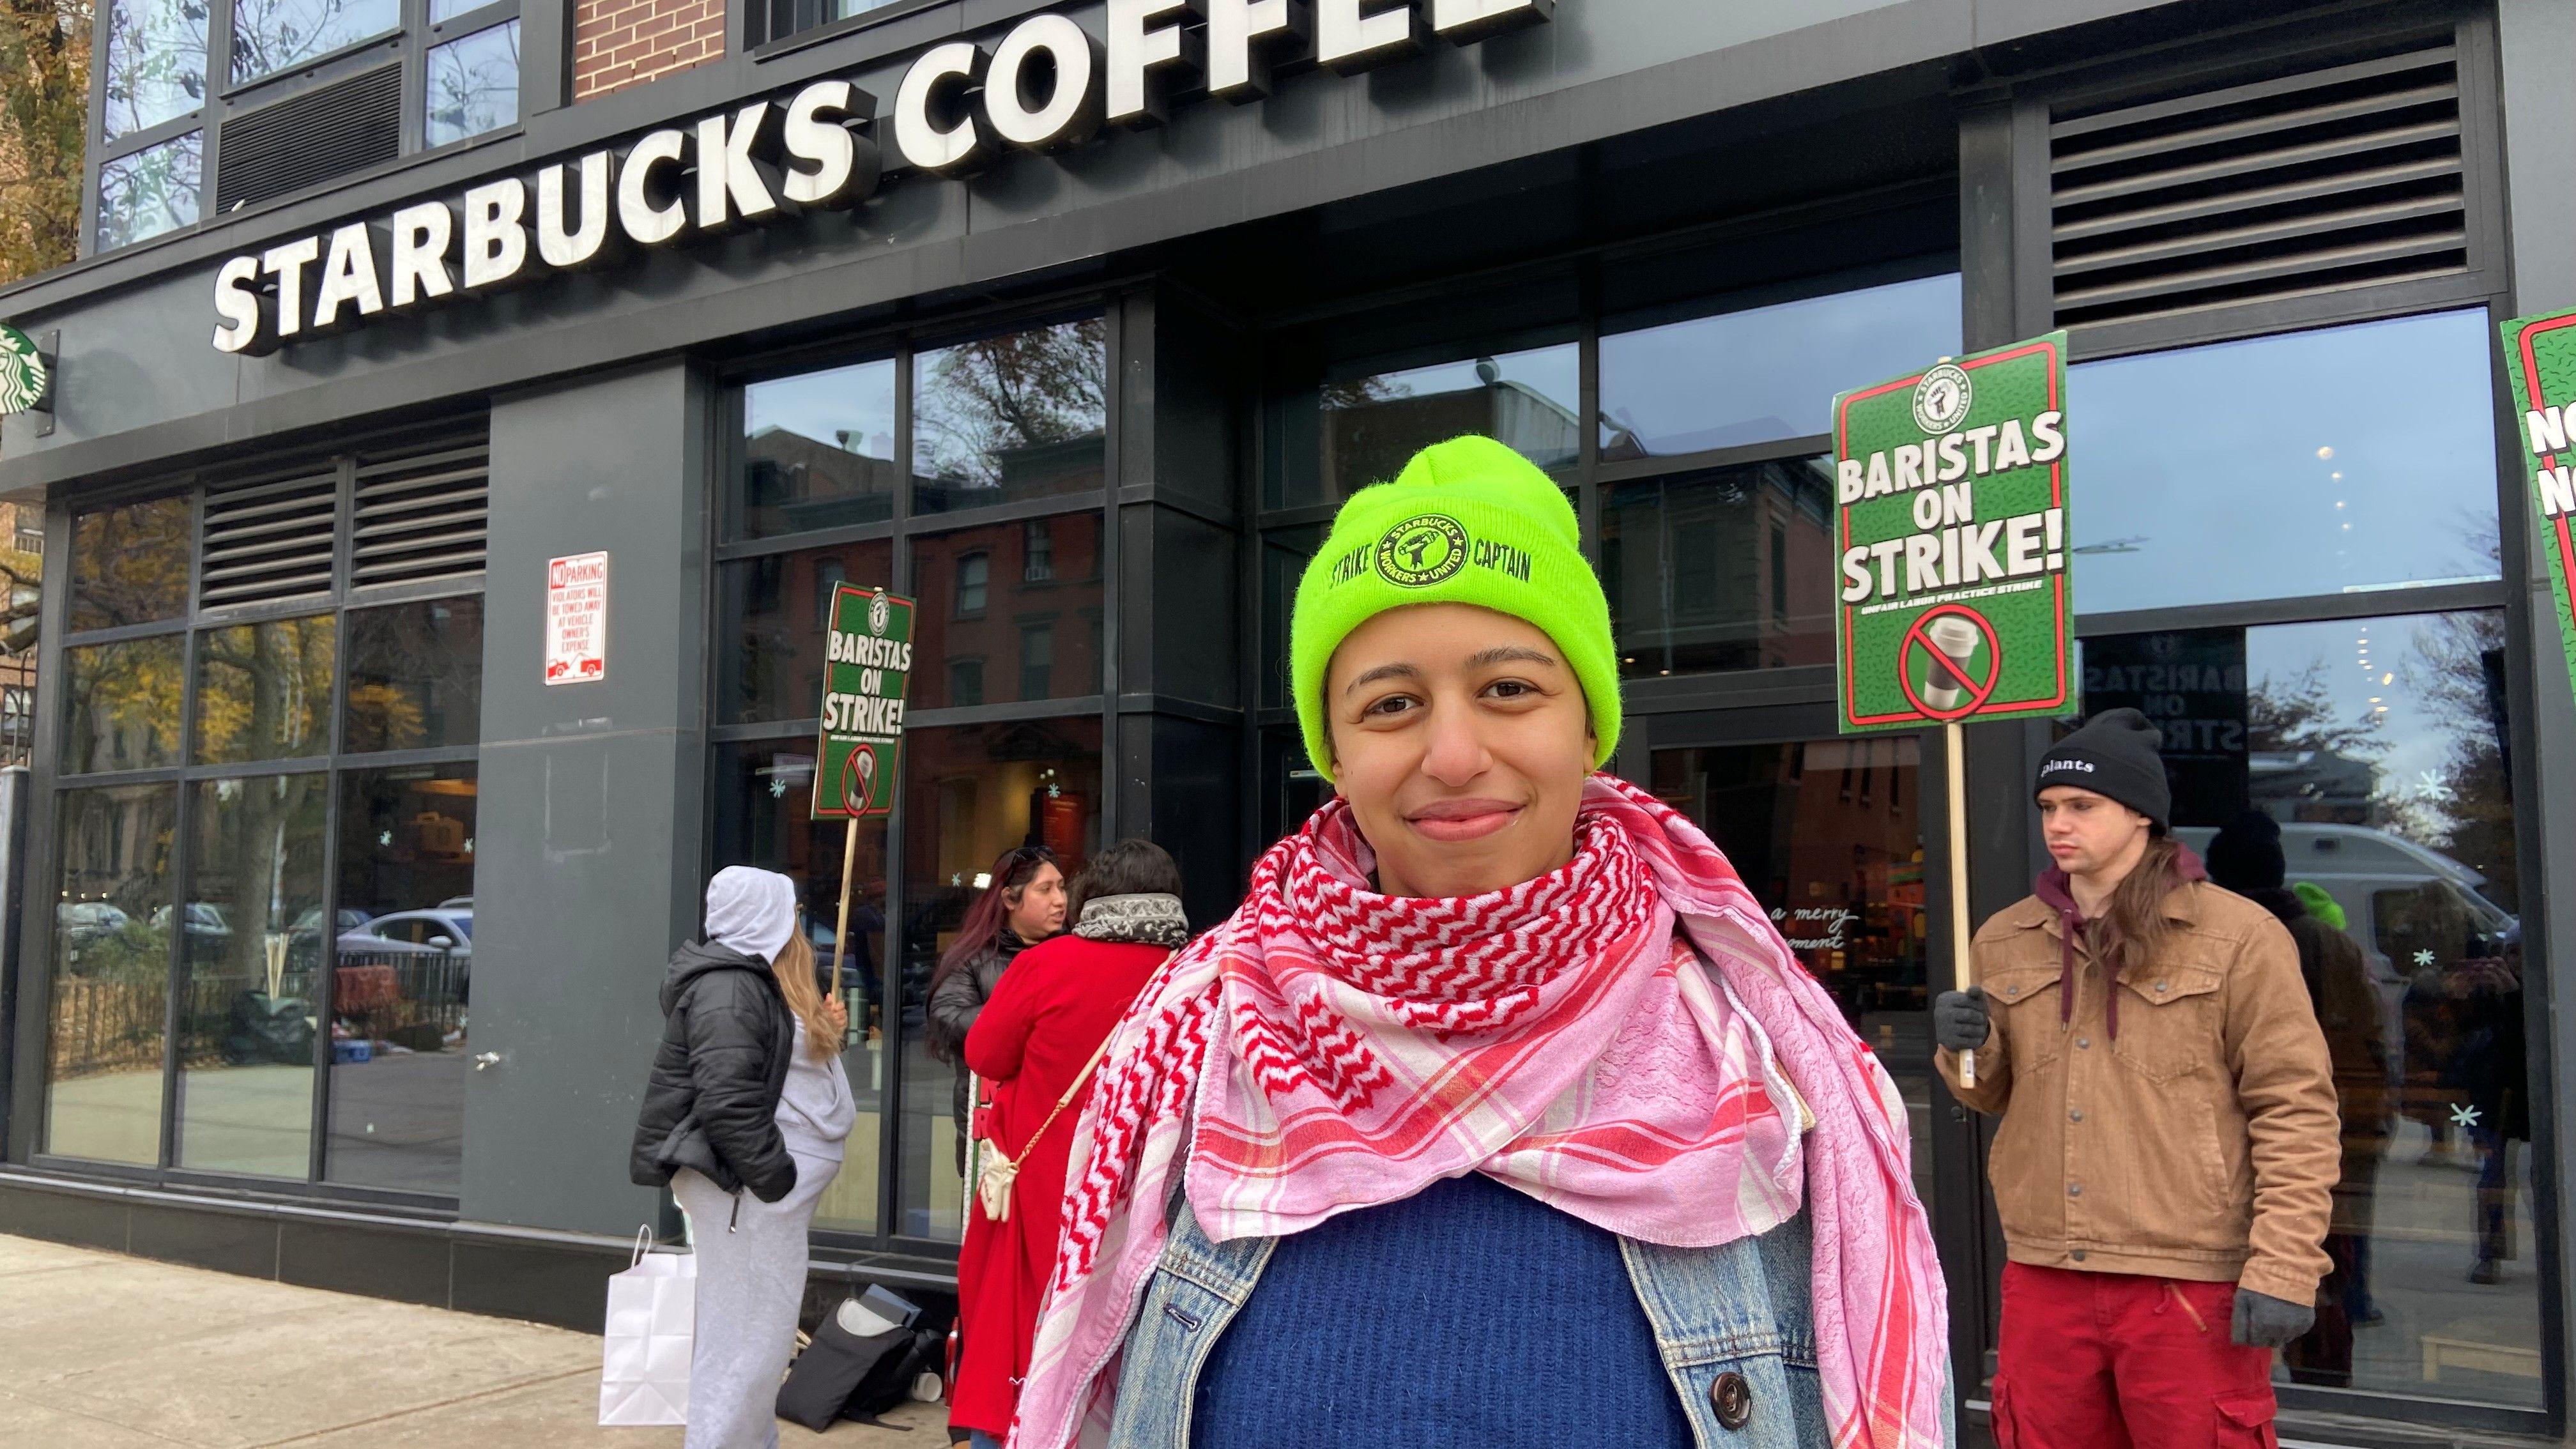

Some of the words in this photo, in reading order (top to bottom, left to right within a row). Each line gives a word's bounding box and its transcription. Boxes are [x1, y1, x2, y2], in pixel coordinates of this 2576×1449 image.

[211, 79, 855, 353] STARBUCKS
[894, 0, 1533, 171] COFF
[1837, 410, 2066, 505] BARISTAS
[1913, 480, 1974, 530] ON
[1391, 518, 1458, 539] STARBUCKS
[1329, 542, 1373, 590] STRIKE
[1473, 537, 1531, 583] CAPTAIN
[1380, 550, 1417, 583] WORKERS
[1429, 548, 1462, 580] UNITED
[1841, 507, 2064, 604] STRIKE!
[552, 564, 565, 585] NO
[566, 562, 602, 583] PARKING
[552, 588, 586, 602] VIOLATORS
[587, 586, 602, 598] WILL
[562, 602, 583, 615] TOWED
[584, 600, 601, 611] AWAY
[1861, 601, 1899, 615] UNFAIR
[1900, 595, 1936, 610] LABOR
[1937, 586, 1996, 602] PRACTICE
[1997, 579, 2043, 594] STRIKE
[558, 616, 566, 629] AT
[567, 613, 594, 626] VEHICLE
[828, 629, 912, 673] BARISTAS
[860, 668, 882, 695] ON
[823, 691, 905, 735] STRIKE!
[1770, 907, 1787, 921] a
[1794, 907, 1860, 934] merry
[1785, 930, 1846, 949] oment
